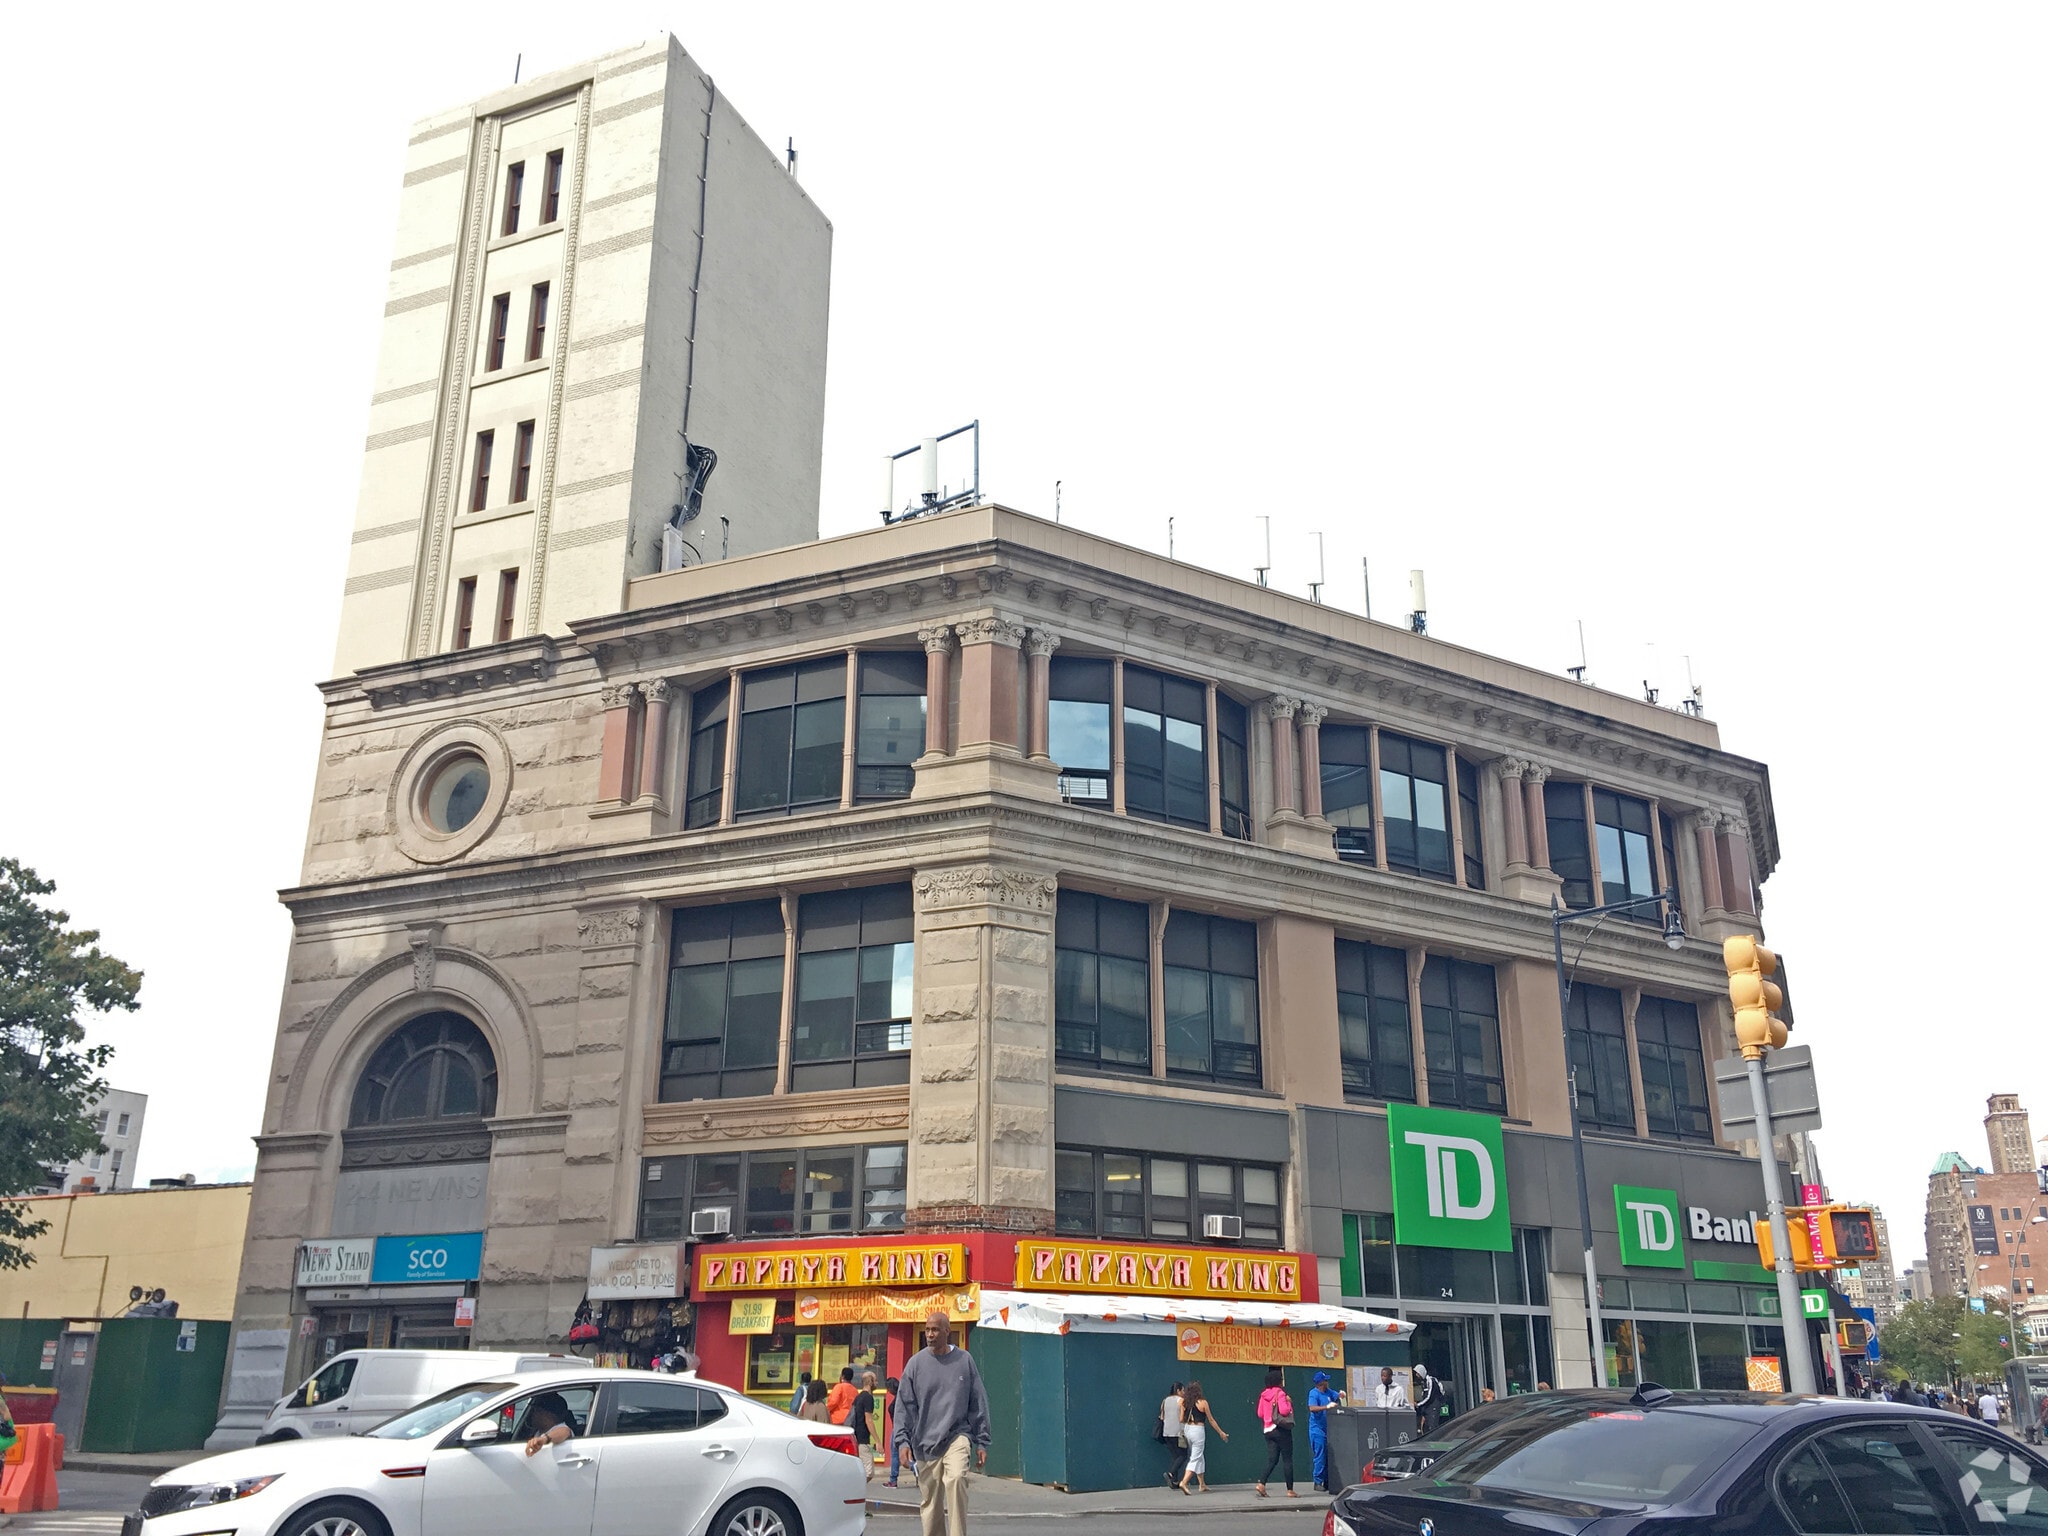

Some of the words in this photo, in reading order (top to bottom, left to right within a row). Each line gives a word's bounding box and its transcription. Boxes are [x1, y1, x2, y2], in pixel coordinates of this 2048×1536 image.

[1404, 1130, 1496, 1221] TD
[388, 1176, 481, 1203] NEVINS
[1626, 1201, 1675, 1251] TD
[302, 1245, 332, 1272] NEWS
[335, 1246, 370, 1272] STAND
[408, 1249, 447, 1269] SCO
[608, 1259, 648, 1271] WELCOME
[650, 1258, 661, 1269] TO
[707, 1256, 843, 1285] PAPAYA
[863, 1252, 949, 1279] KING
[1036, 1250, 1190, 1287] PAPAYA
[1211, 1260, 1296, 1293] KING
[1441, 1287, 1453, 1298] 2-4
[1802, 1294, 1825, 1313] TD
[743, 1303, 763, 1316] $1.99
[731, 1316, 771, 1328] BREAKFAST
[1209, 1326, 1270, 1347] CELEBRATING
[1272, 1331, 1283, 1348] 85
[1285, 1331, 1314, 1350] YEARS
[1204, 1345, 1241, 1360] BREAKFAST
[1245, 1348, 1267, 1362] LUNCH
[1271, 1350, 1294, 1363] DINNER
[1298, 1351, 1319, 1364] SNACK
